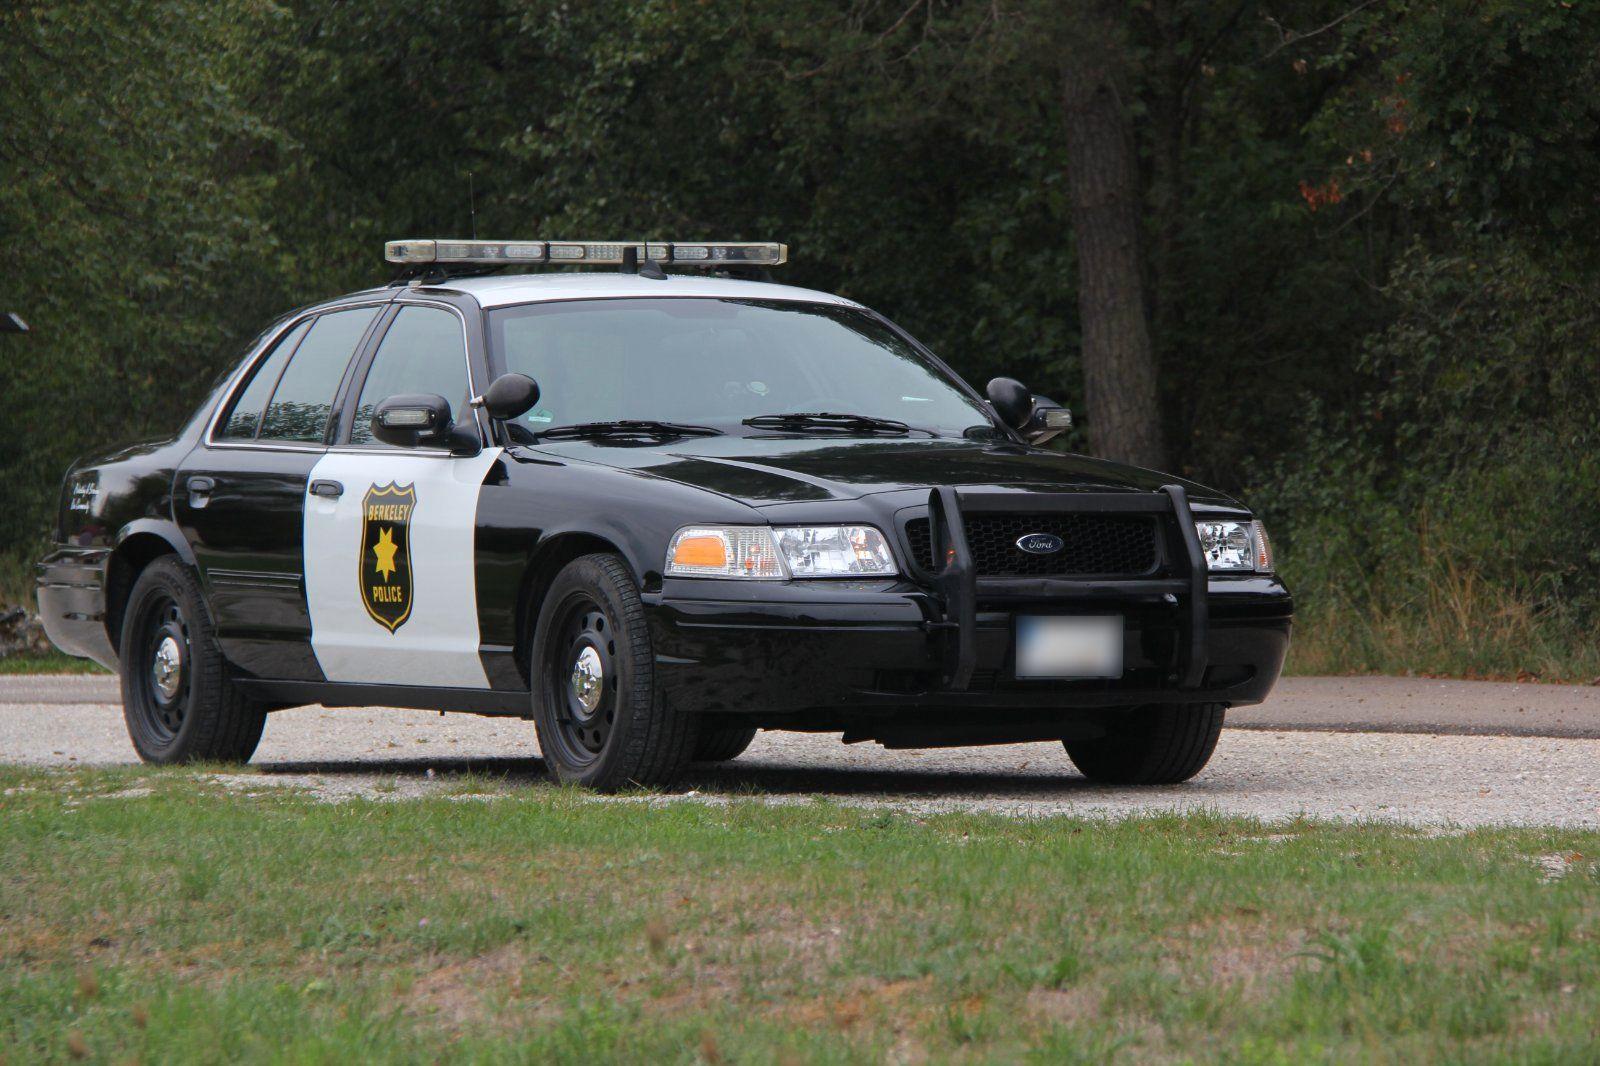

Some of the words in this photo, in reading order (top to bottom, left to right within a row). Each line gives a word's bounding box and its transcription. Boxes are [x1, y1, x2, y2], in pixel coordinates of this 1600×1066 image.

[368, 504, 410, 521] BERKELEY
[1028, 538, 1053, 549] Ford
[372, 586, 402, 603] POLICE
